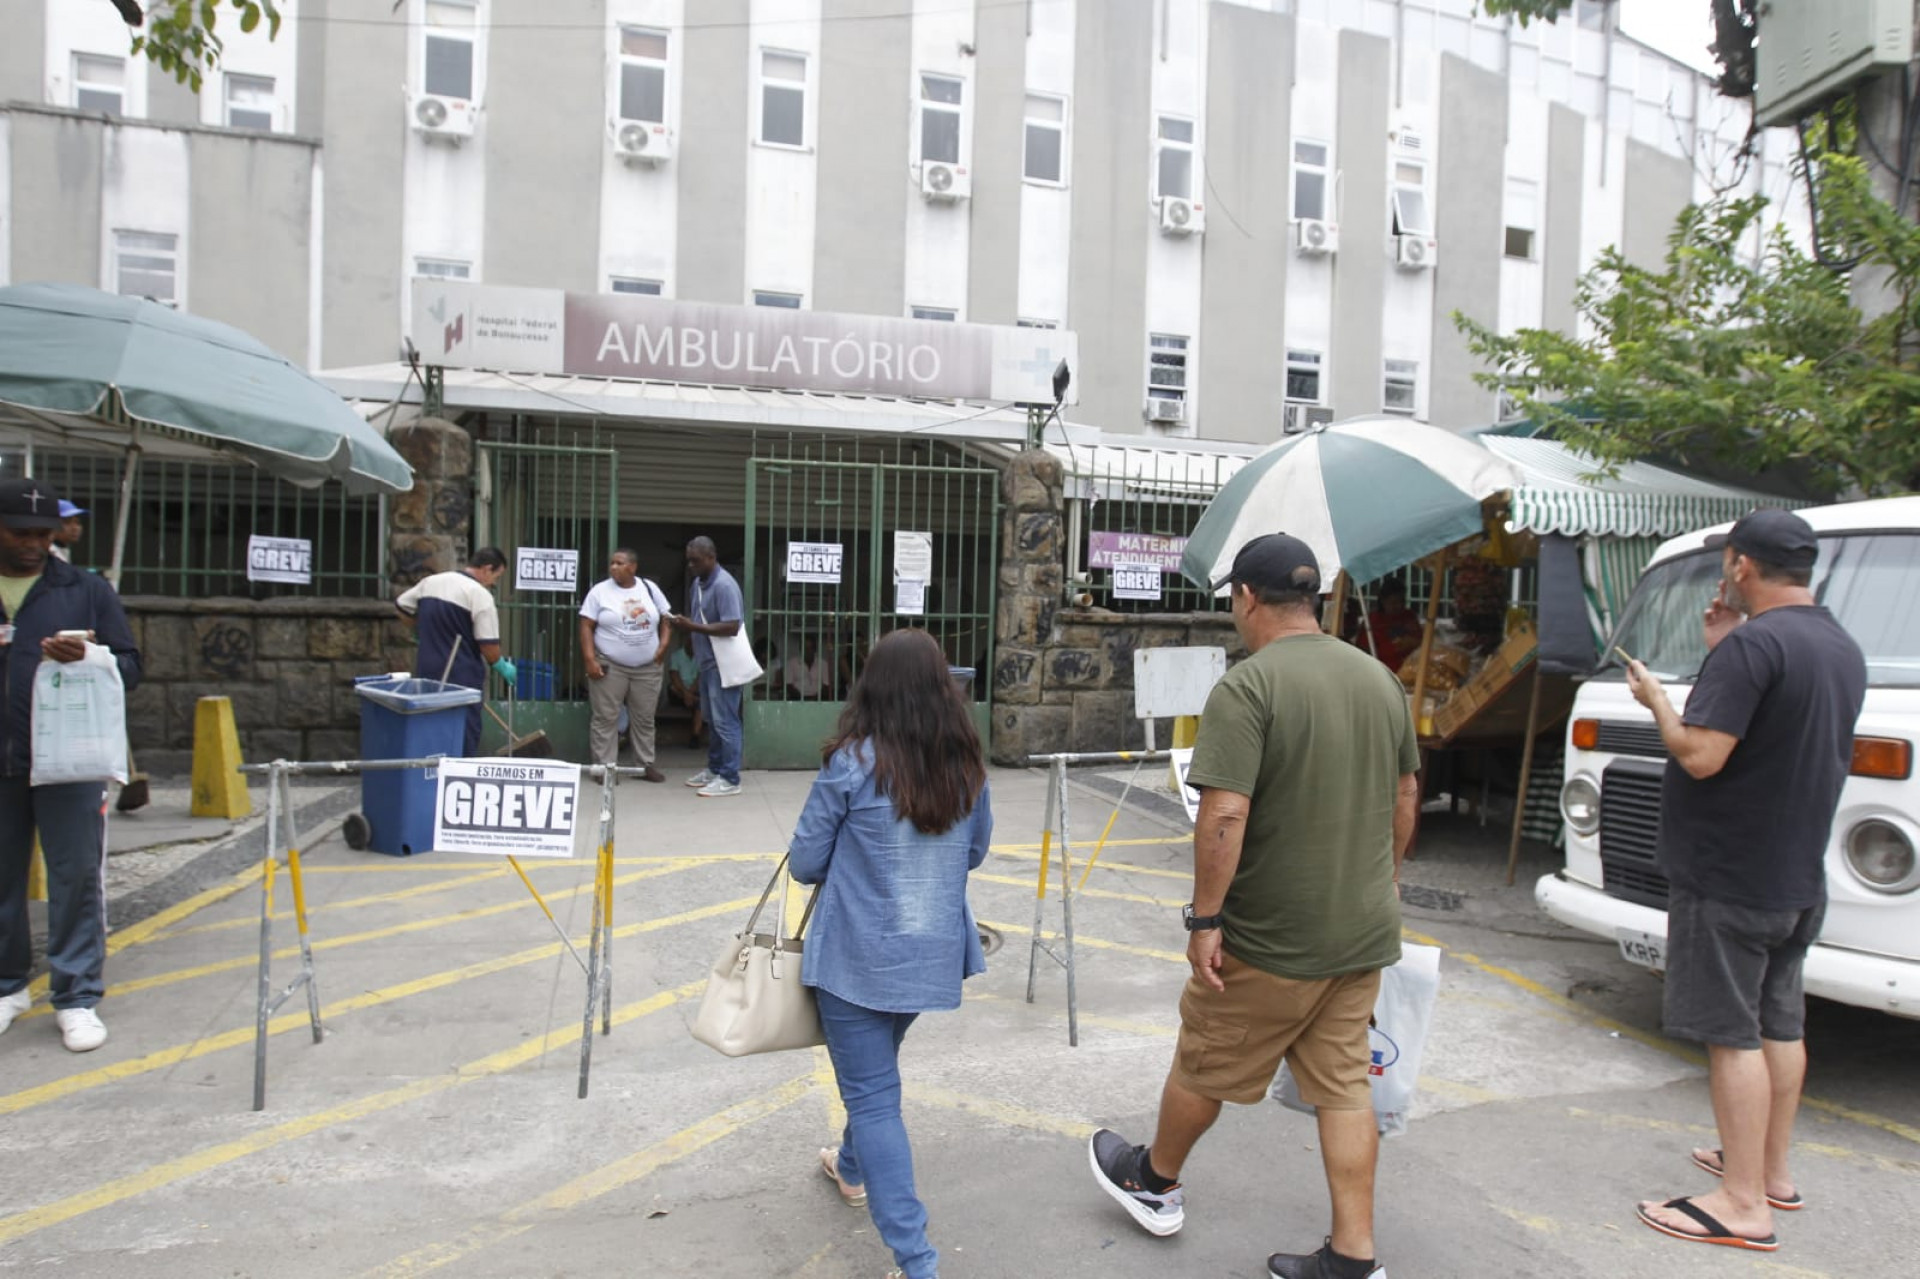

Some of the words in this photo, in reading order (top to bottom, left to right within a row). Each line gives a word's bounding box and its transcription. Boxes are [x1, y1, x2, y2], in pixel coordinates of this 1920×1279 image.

[596, 322, 941, 383] AMBULATÓRIO
[1119, 535, 1189, 553] MATERNI
[251, 548, 311, 572] GREVE
[791, 553, 841, 573] GREVE
[1092, 550, 1182, 568] ATENDIMENT
[520, 559, 576, 580] GREVE
[1116, 571, 1159, 590] GREVE
[477, 766, 527, 779] ESTAMOS
[529, 768, 545, 780] EM
[444, 780, 573, 830] GREVE
